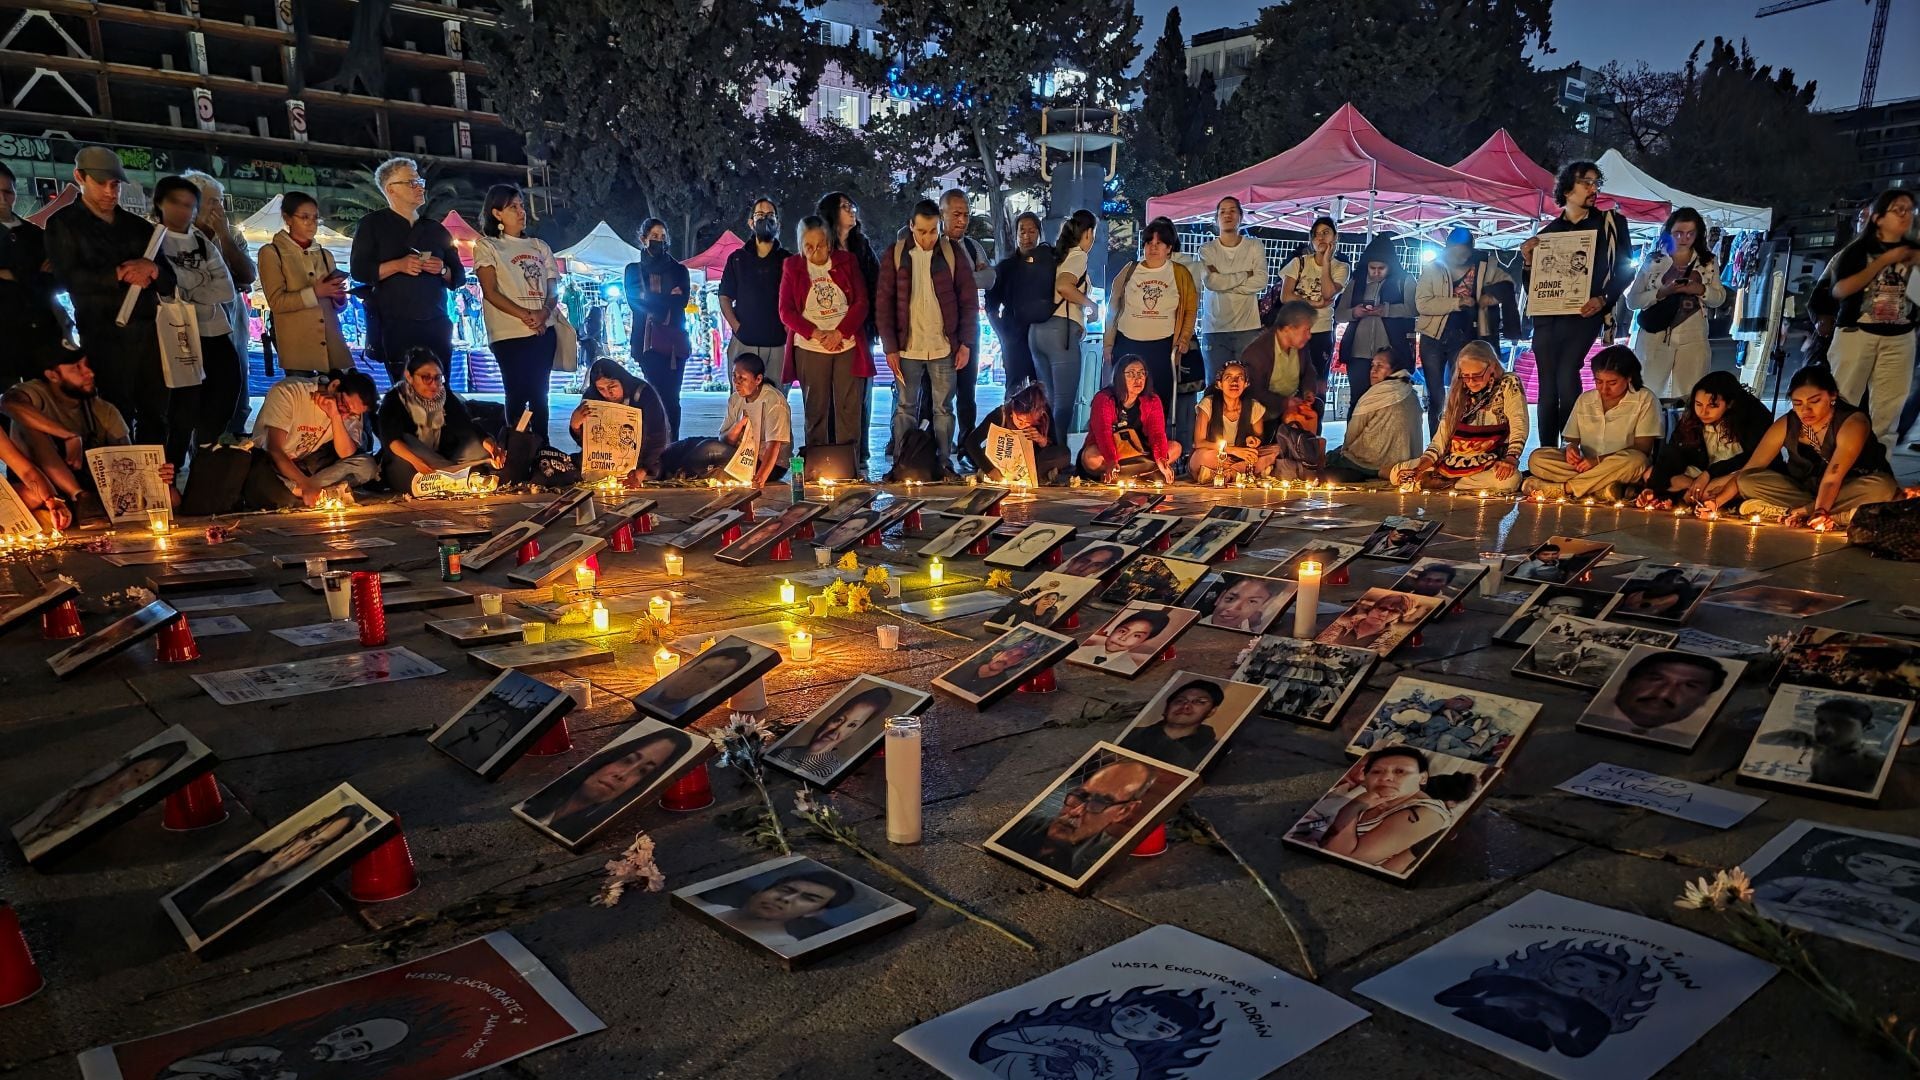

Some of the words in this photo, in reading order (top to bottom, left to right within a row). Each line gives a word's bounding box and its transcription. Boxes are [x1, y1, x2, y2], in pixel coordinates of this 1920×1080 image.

[1534, 280, 1562, 291] ¿DÓNDE
[587, 450, 613, 462] ¿DÓNDE
[590, 460, 616, 471] ESTÁN?
[1561, 925, 1665, 952] ENCONTRARTE
[1164, 964, 1262, 996] ENCONTRARTE
[1652, 953, 1702, 990] JUAN
[405, 971, 452, 981] HASTA
[453, 976, 525, 1014] ENCONTRARTE
[482, 1013, 500, 1036] JUAN
[1234, 1000, 1273, 1038] ADRIÁN
